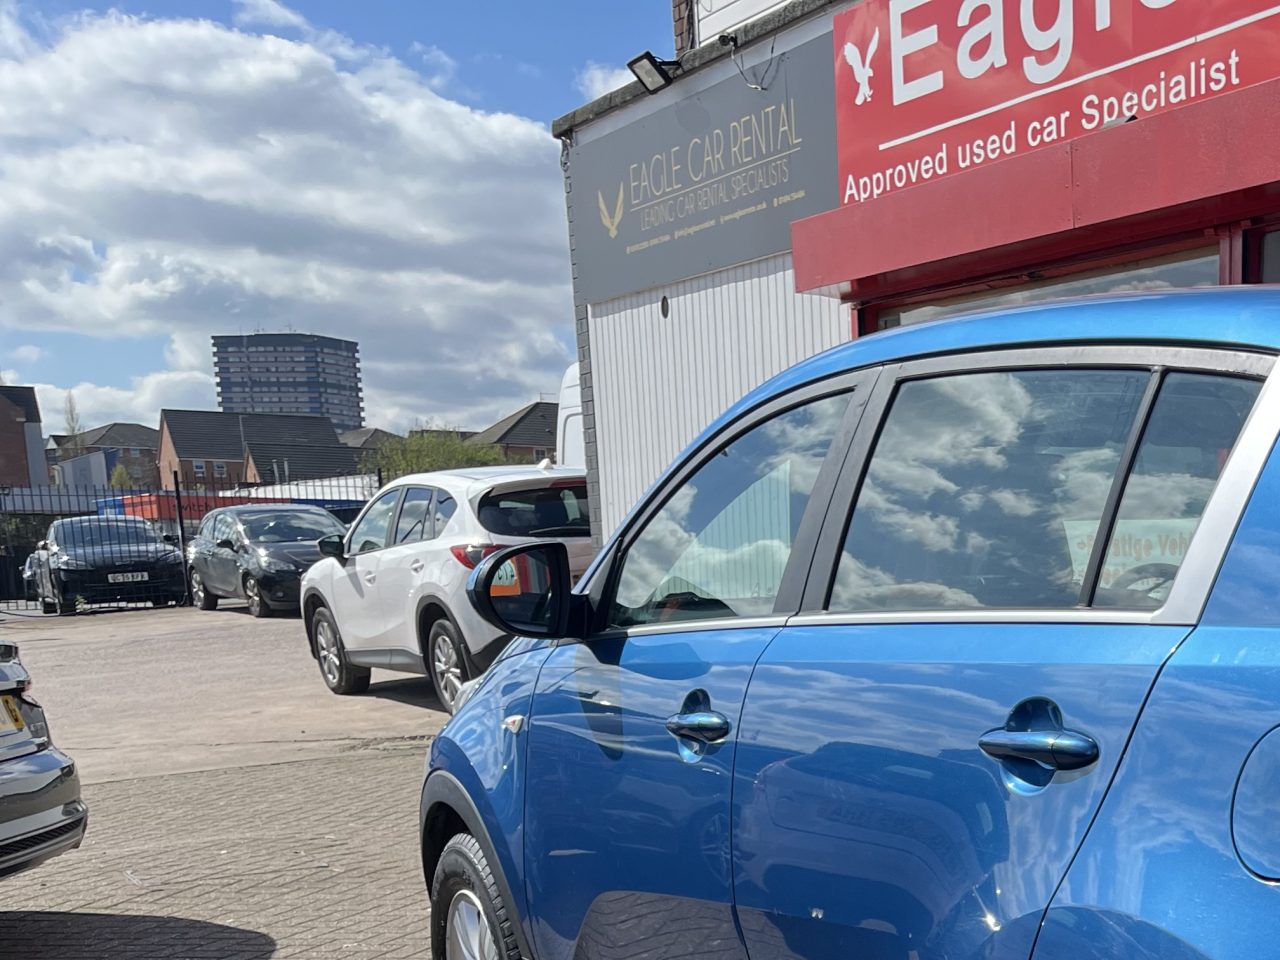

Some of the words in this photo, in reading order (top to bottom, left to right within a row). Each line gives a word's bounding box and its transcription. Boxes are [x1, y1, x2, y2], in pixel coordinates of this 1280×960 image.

[888, 0, 1179, 106] Eag
[629, 145, 682, 205] EAGLE
[687, 129, 726, 183] CAR
[730, 97, 803, 168] RENTAL
[843, 143, 948, 204] Approved
[957, 121, 1017, 169] used
[1026, 110, 1071, 149] car
[1080, 48, 1241, 131] Specialist
[640, 200, 675, 231] LEADING
[676, 192, 696, 218] CAR
[697, 182, 729, 212] RENTAL
[730, 158, 790, 200] SPECIALISTS
